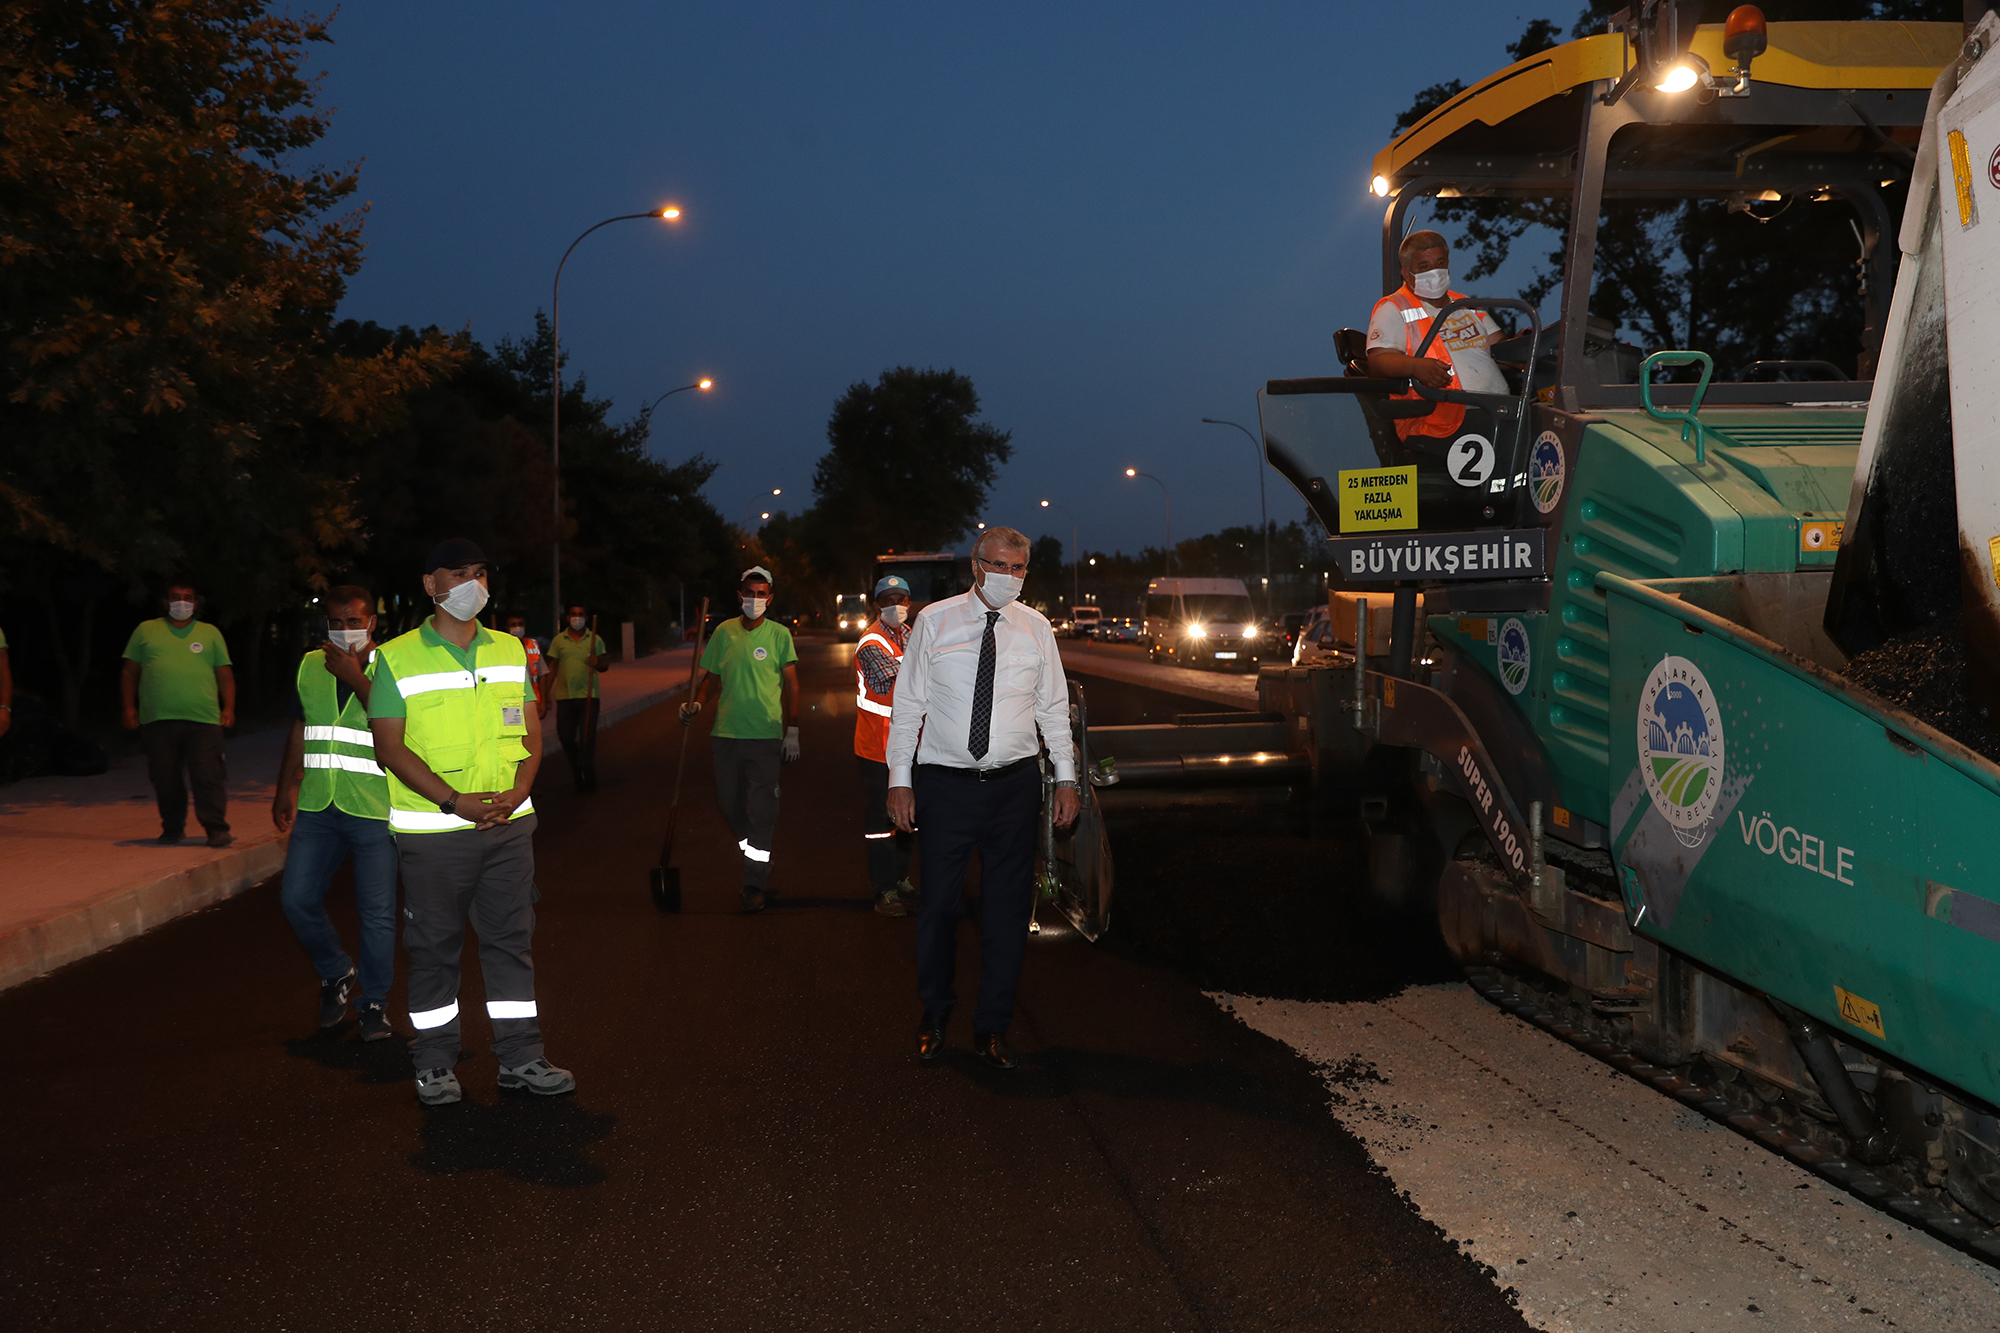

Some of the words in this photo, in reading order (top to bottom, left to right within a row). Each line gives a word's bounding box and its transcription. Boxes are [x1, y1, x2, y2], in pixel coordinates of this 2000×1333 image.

[1458, 440, 1484, 481] 2
[1348, 477, 1359, 489] 25
[1361, 474, 1408, 488] METREDEN
[1364, 492, 1392, 504] FAZLA
[1354, 508, 1402, 522] YAKLAŞMA
[1351, 535, 1532, 574] BÜYÜKŞEHİR
[1457, 745, 1493, 815] SUPER
[1738, 810, 1854, 887] VÖGELE
